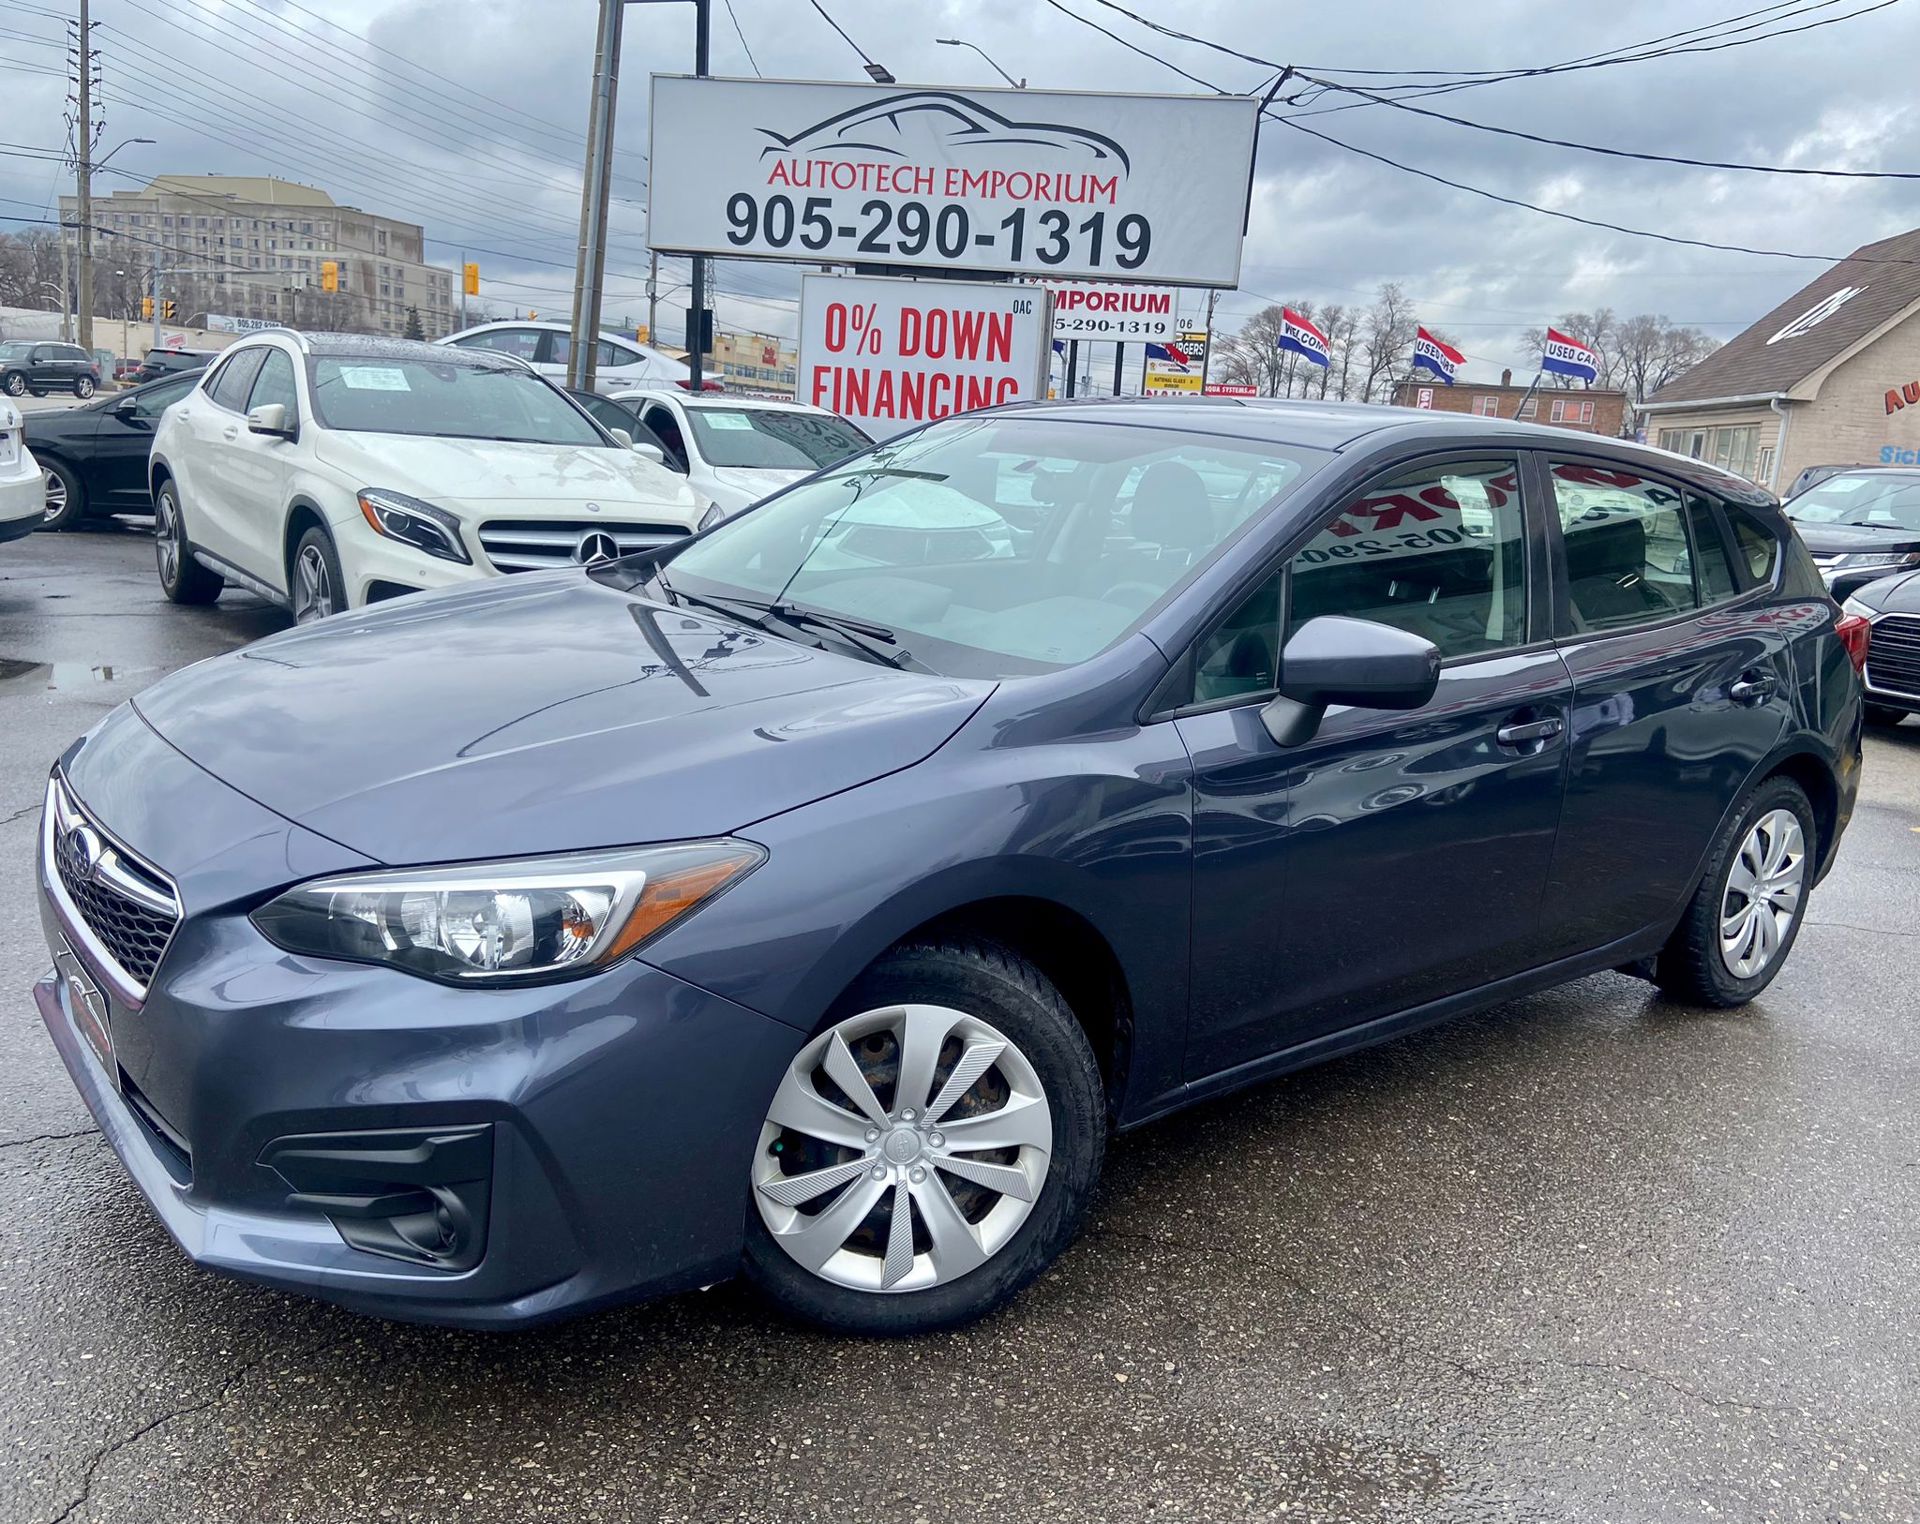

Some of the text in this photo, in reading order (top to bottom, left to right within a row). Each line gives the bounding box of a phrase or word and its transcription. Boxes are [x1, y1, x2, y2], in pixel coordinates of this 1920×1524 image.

[766, 158, 1119, 204] AUTOTECH EMPORIUM
[725, 192, 1152, 271] 905-290-1319
[1012, 299, 1032, 315] OAC
[1047, 290, 1171, 315] MPORIUM
[824, 302, 1014, 363] 0% DOWN
[1054, 317, 1167, 335] 5-290-1319
[1176, 318, 1193, 330] 06
[1175, 342, 1204, 355] RGERS
[1417, 340, 1440, 360] USED
[1548, 343, 1575, 360] USED
